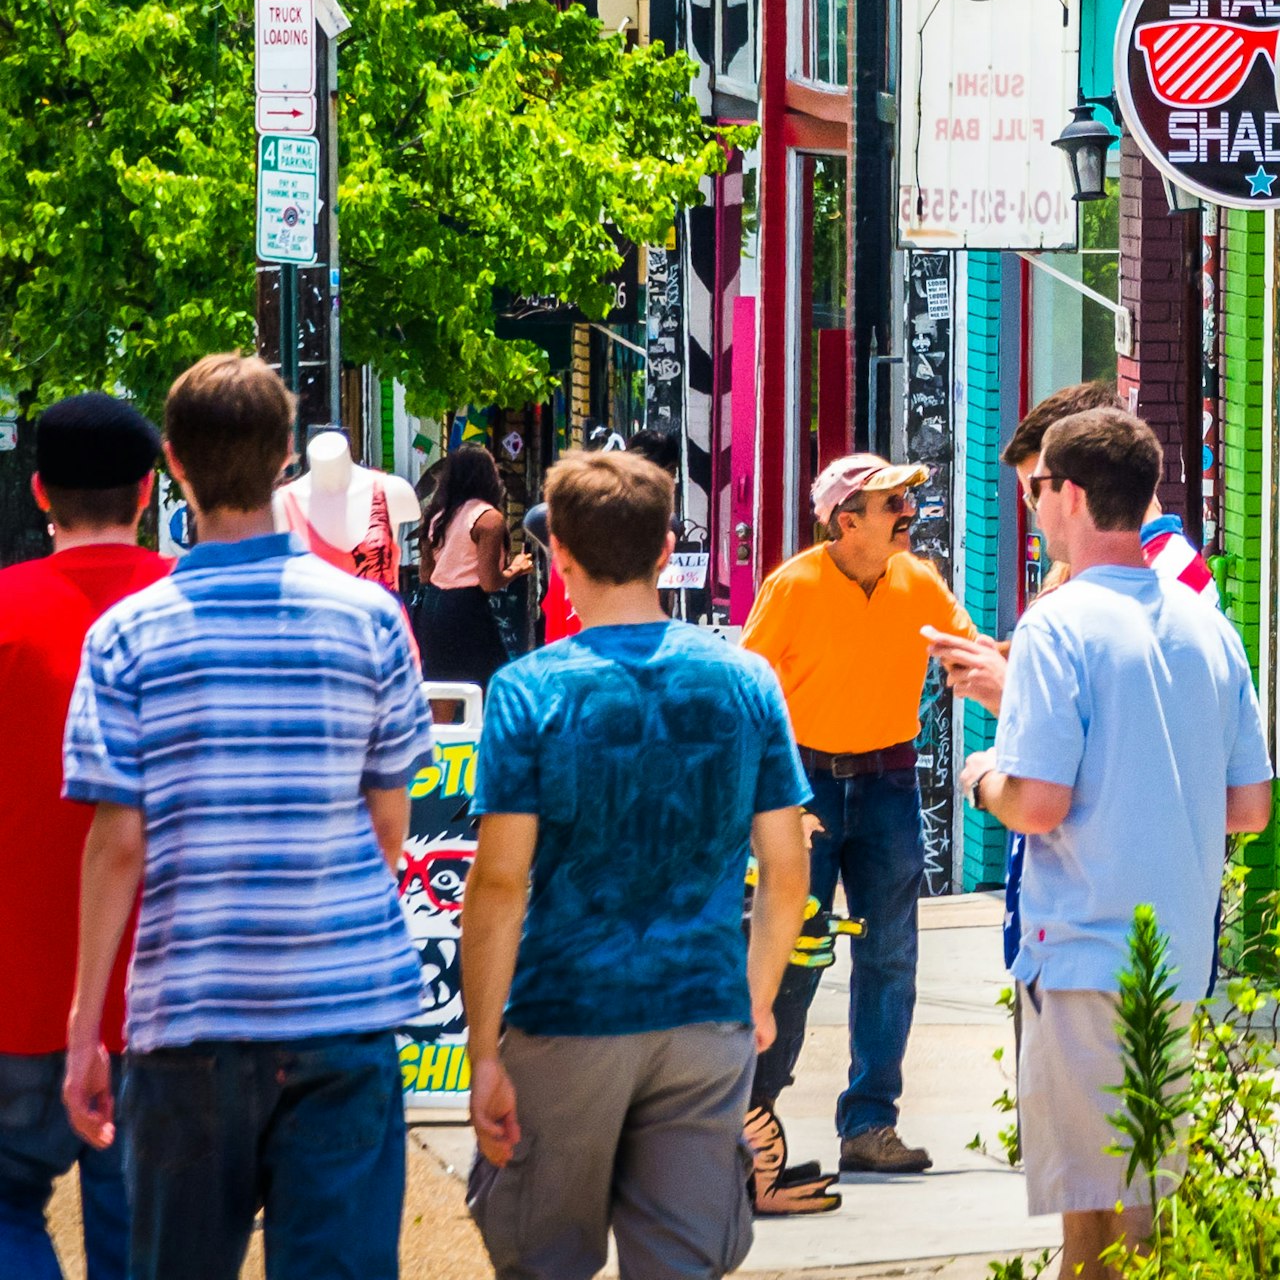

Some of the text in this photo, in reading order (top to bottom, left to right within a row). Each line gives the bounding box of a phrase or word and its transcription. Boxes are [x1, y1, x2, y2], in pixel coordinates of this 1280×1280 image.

[269, 7, 303, 23] TRUCK
[263, 29, 308, 45] LOADING
[263, 140, 276, 168] 4
[281, 156, 313, 170] PARKING
